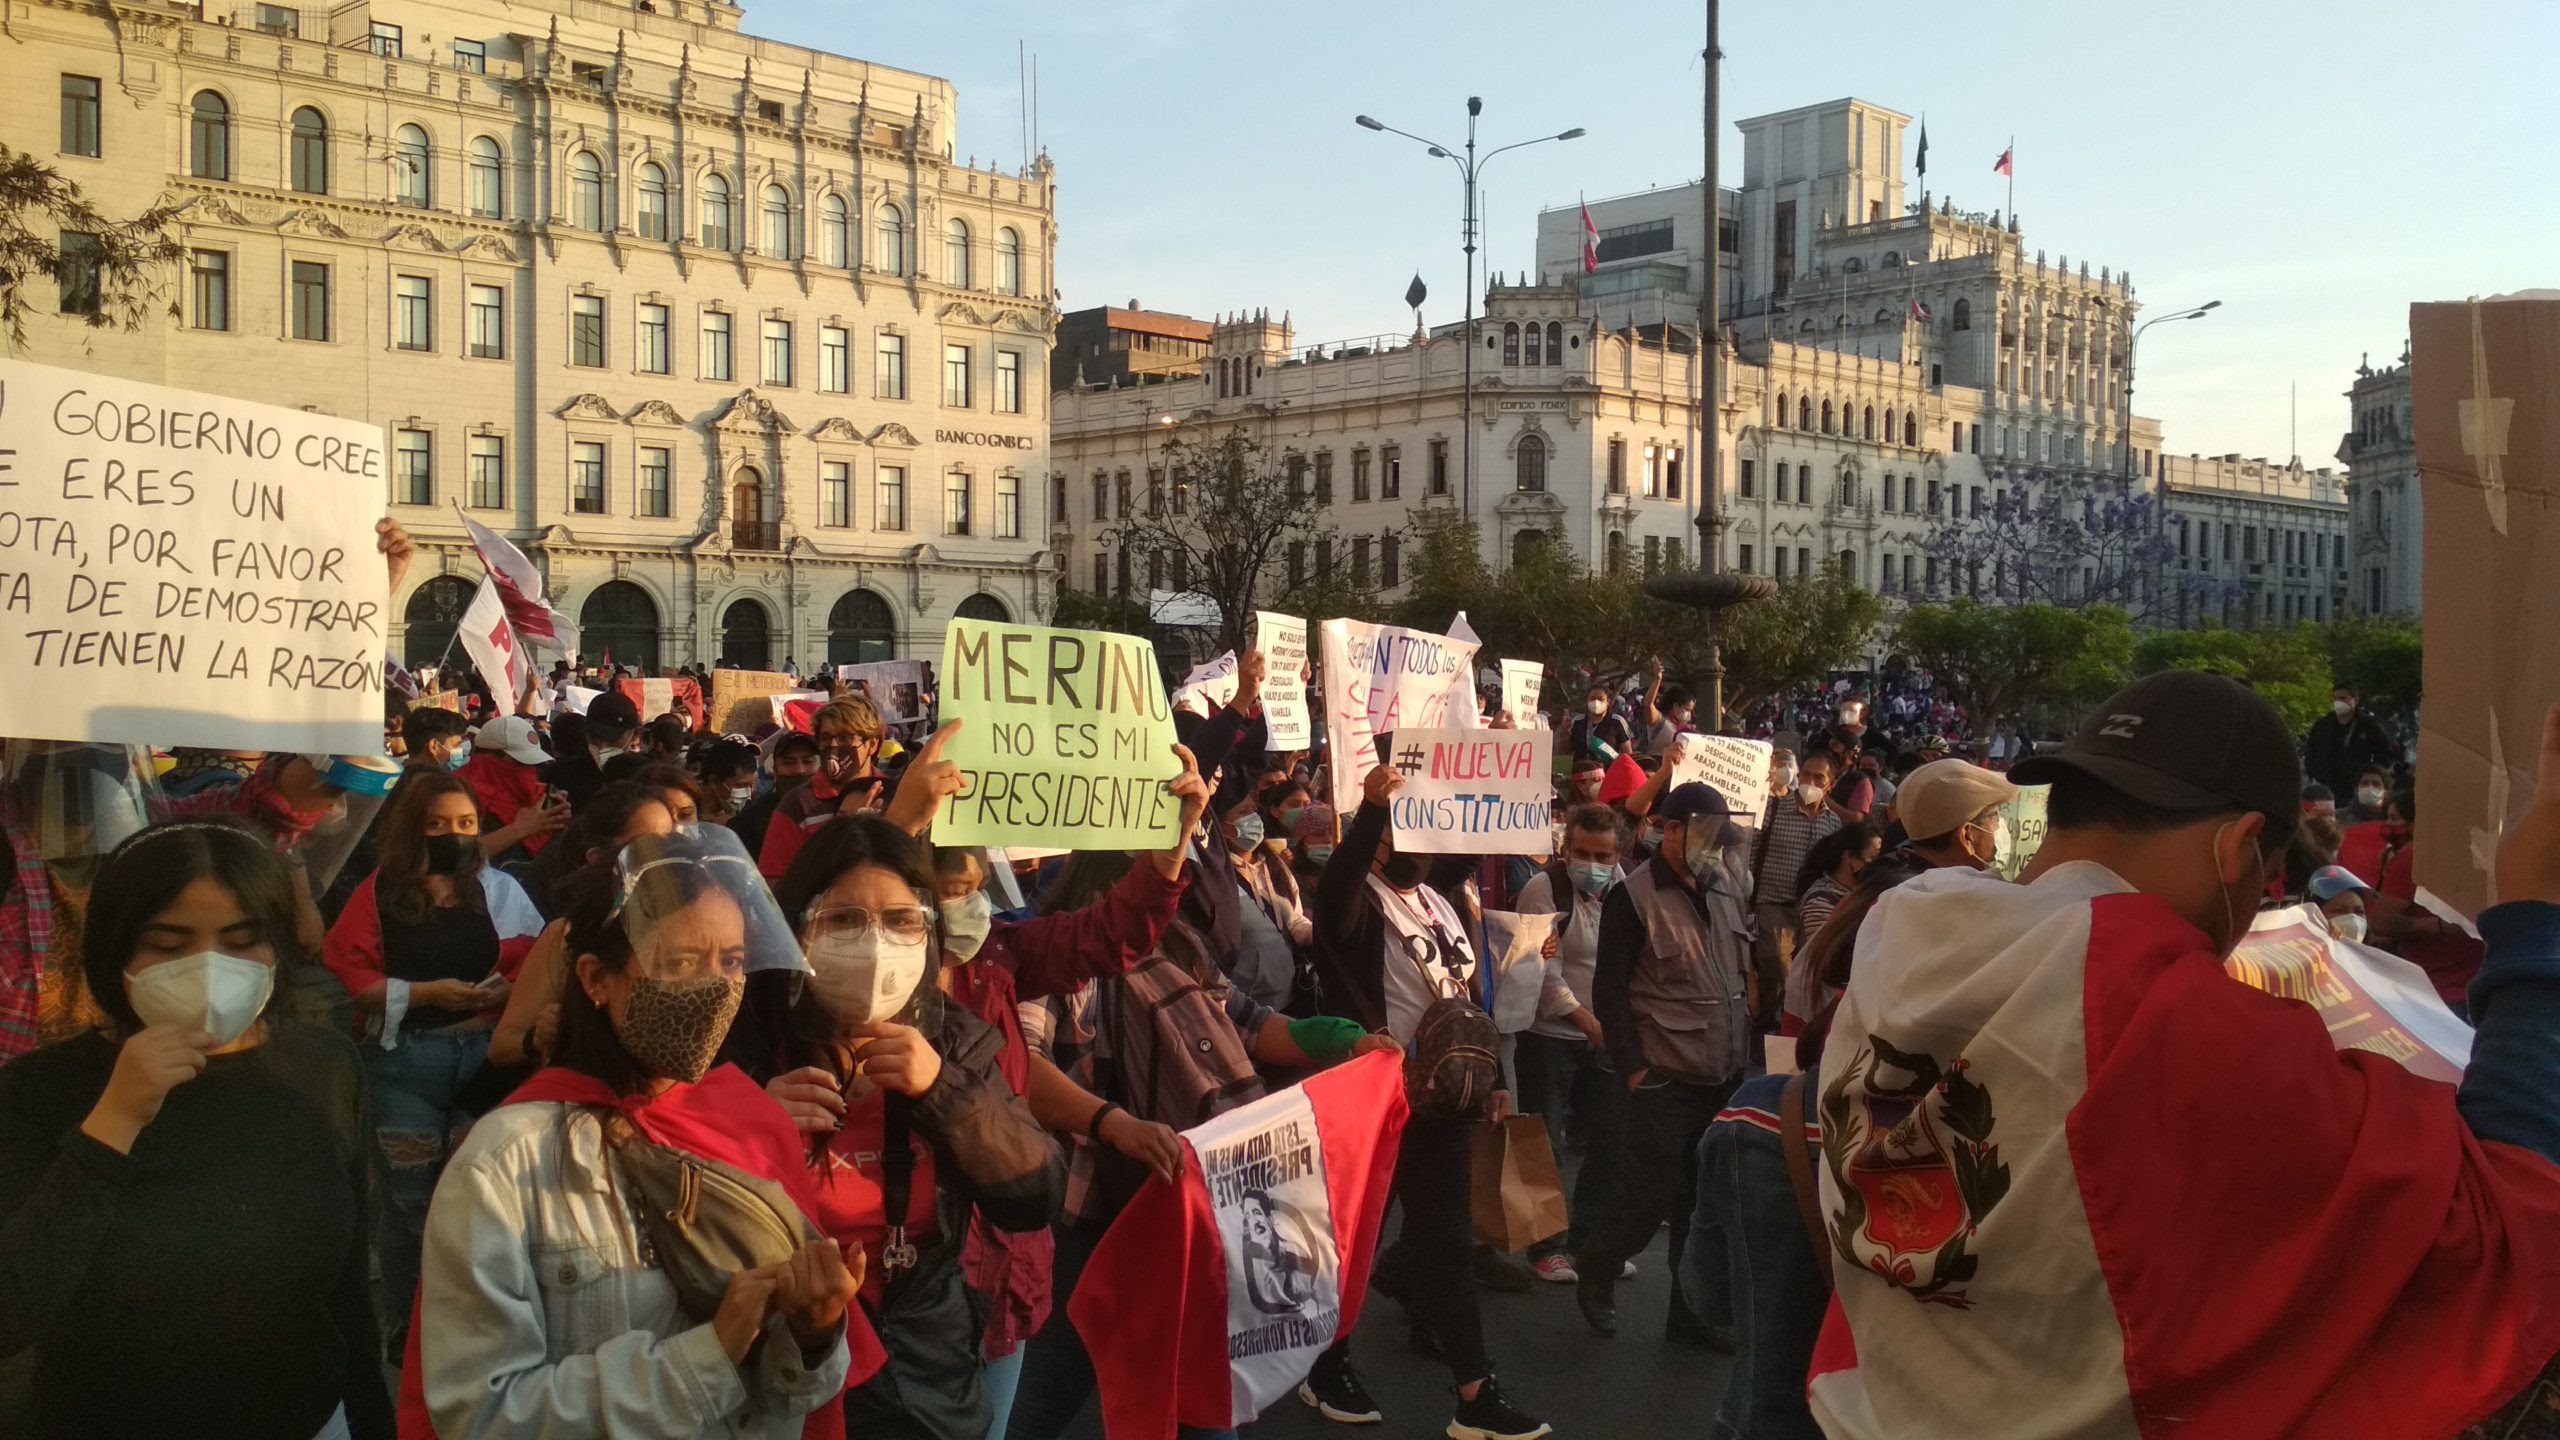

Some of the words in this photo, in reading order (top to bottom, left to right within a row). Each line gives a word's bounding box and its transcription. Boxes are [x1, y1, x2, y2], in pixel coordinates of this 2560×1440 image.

[1500, 401, 1536, 410] EDIFICIO
[53, 389, 282, 460] GOBIERNO
[295, 434, 381, 478] CREE
[935, 429, 986, 447] BANCO
[987, 433, 1016, 449] GNB
[62, 457, 195, 506] ERES
[232, 478, 284, 522] UN
[109, 523, 194, 575] POR
[212, 538, 344, 584] FAVOR
[66, 573, 127, 618] DE
[155, 581, 379, 638] DEMOSTRAR
[26, 629, 185, 673] TIENEN
[206, 640, 249, 680] LA
[268, 647, 384, 693] RAZÓN
[953, 627, 1169, 722] MERINO
[1399, 637, 1443, 676] TODOS
[721, 671, 742, 688] SE
[992, 723, 1035, 756] NO
[1055, 723, 1099, 759] ES
[1114, 727, 1148, 762] MI
[1704, 744, 1752, 772] DESIGUALDAD
[1726, 742, 1745, 758] AÑOS
[1746, 752, 1756, 763] DE
[1694, 753, 1716, 769] ABAJO
[1716, 764, 1724, 774] EL
[1726, 768, 1757, 788] MODELO
[1698, 770, 1742, 795] ASAMBLEA
[948, 769, 1173, 830] PRESIDENTE
[1393, 793, 1551, 832] CONSTITUCIÓN
